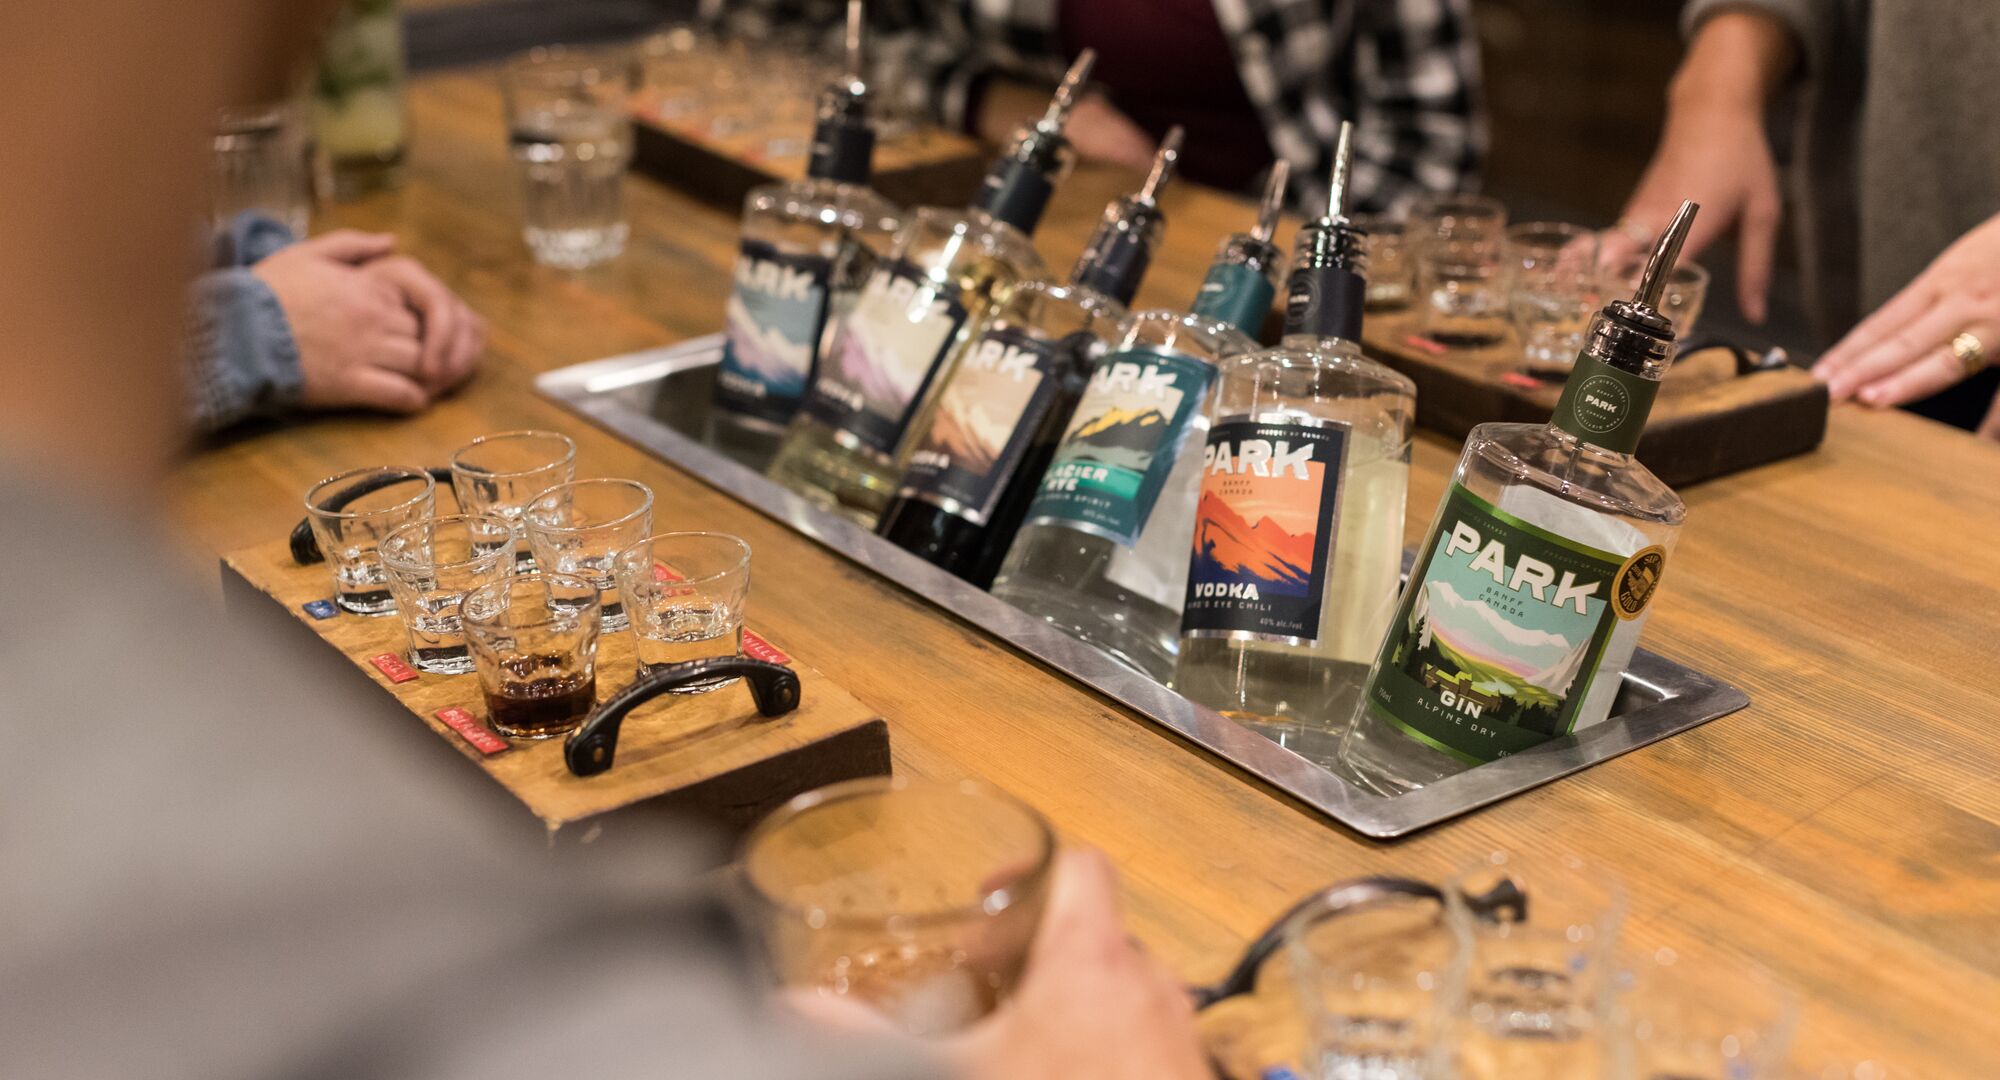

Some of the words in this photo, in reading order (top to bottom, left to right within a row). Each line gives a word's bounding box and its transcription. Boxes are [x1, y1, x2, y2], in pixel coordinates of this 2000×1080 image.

[1585, 393, 1618, 413] PARK
[1202, 438, 1315, 480] PARK
[1444, 519, 1602, 616] PARK
[1194, 582, 1260, 600] VODKA
[1485, 586, 1525, 607] BANFF
[1620, 591, 1639, 612] GOLD
[1213, 601, 1233, 609] EYE
[1238, 601, 1272, 612] CHILI
[1478, 593, 1525, 618] CANADA
[1439, 690, 1483, 719] GIN
[1417, 697, 1464, 726] ALPINE
[1470, 723, 1498, 739] DRY
